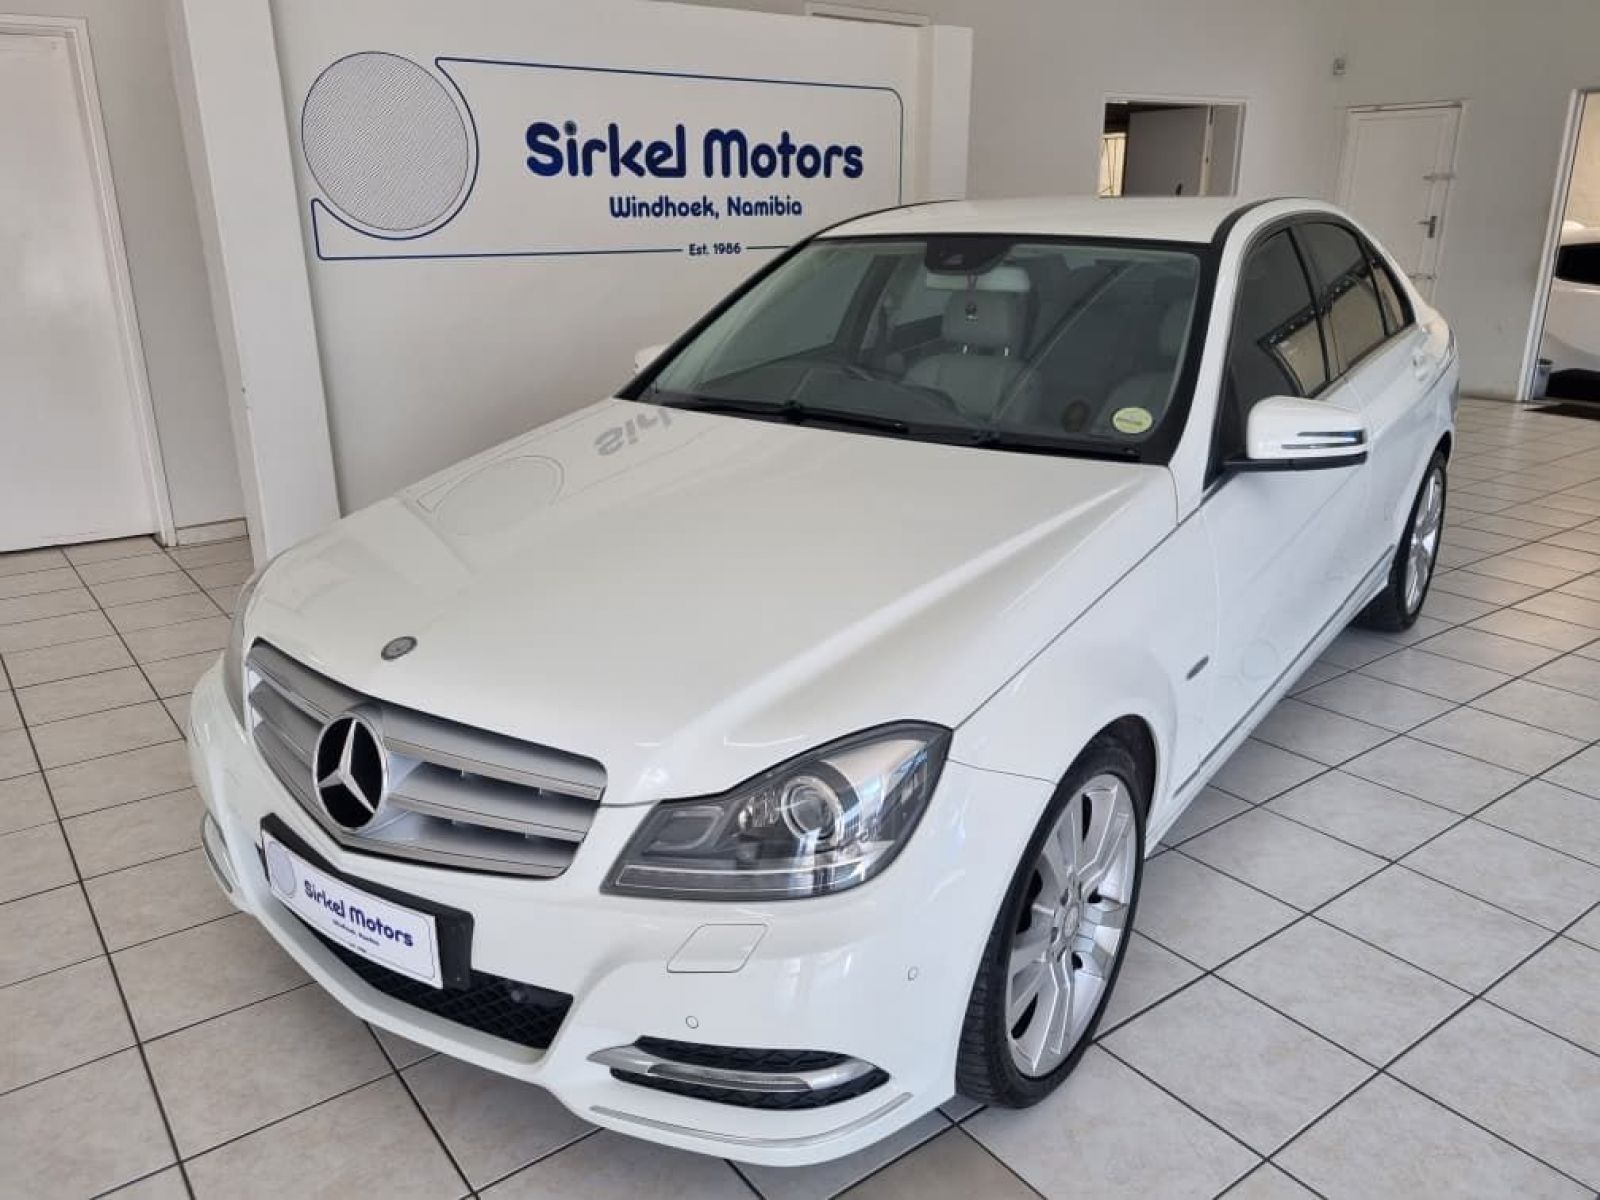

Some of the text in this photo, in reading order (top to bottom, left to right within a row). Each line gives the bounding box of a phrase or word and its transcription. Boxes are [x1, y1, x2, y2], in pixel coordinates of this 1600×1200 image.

[525, 120, 864, 178] Sirkel Motors
[609, 195, 803, 220] Windhoek, Namibia
[688, 241, 742, 257] Est. 1986
[303, 879, 345, 919] Sirkel
[349, 905, 414, 947] Motors
